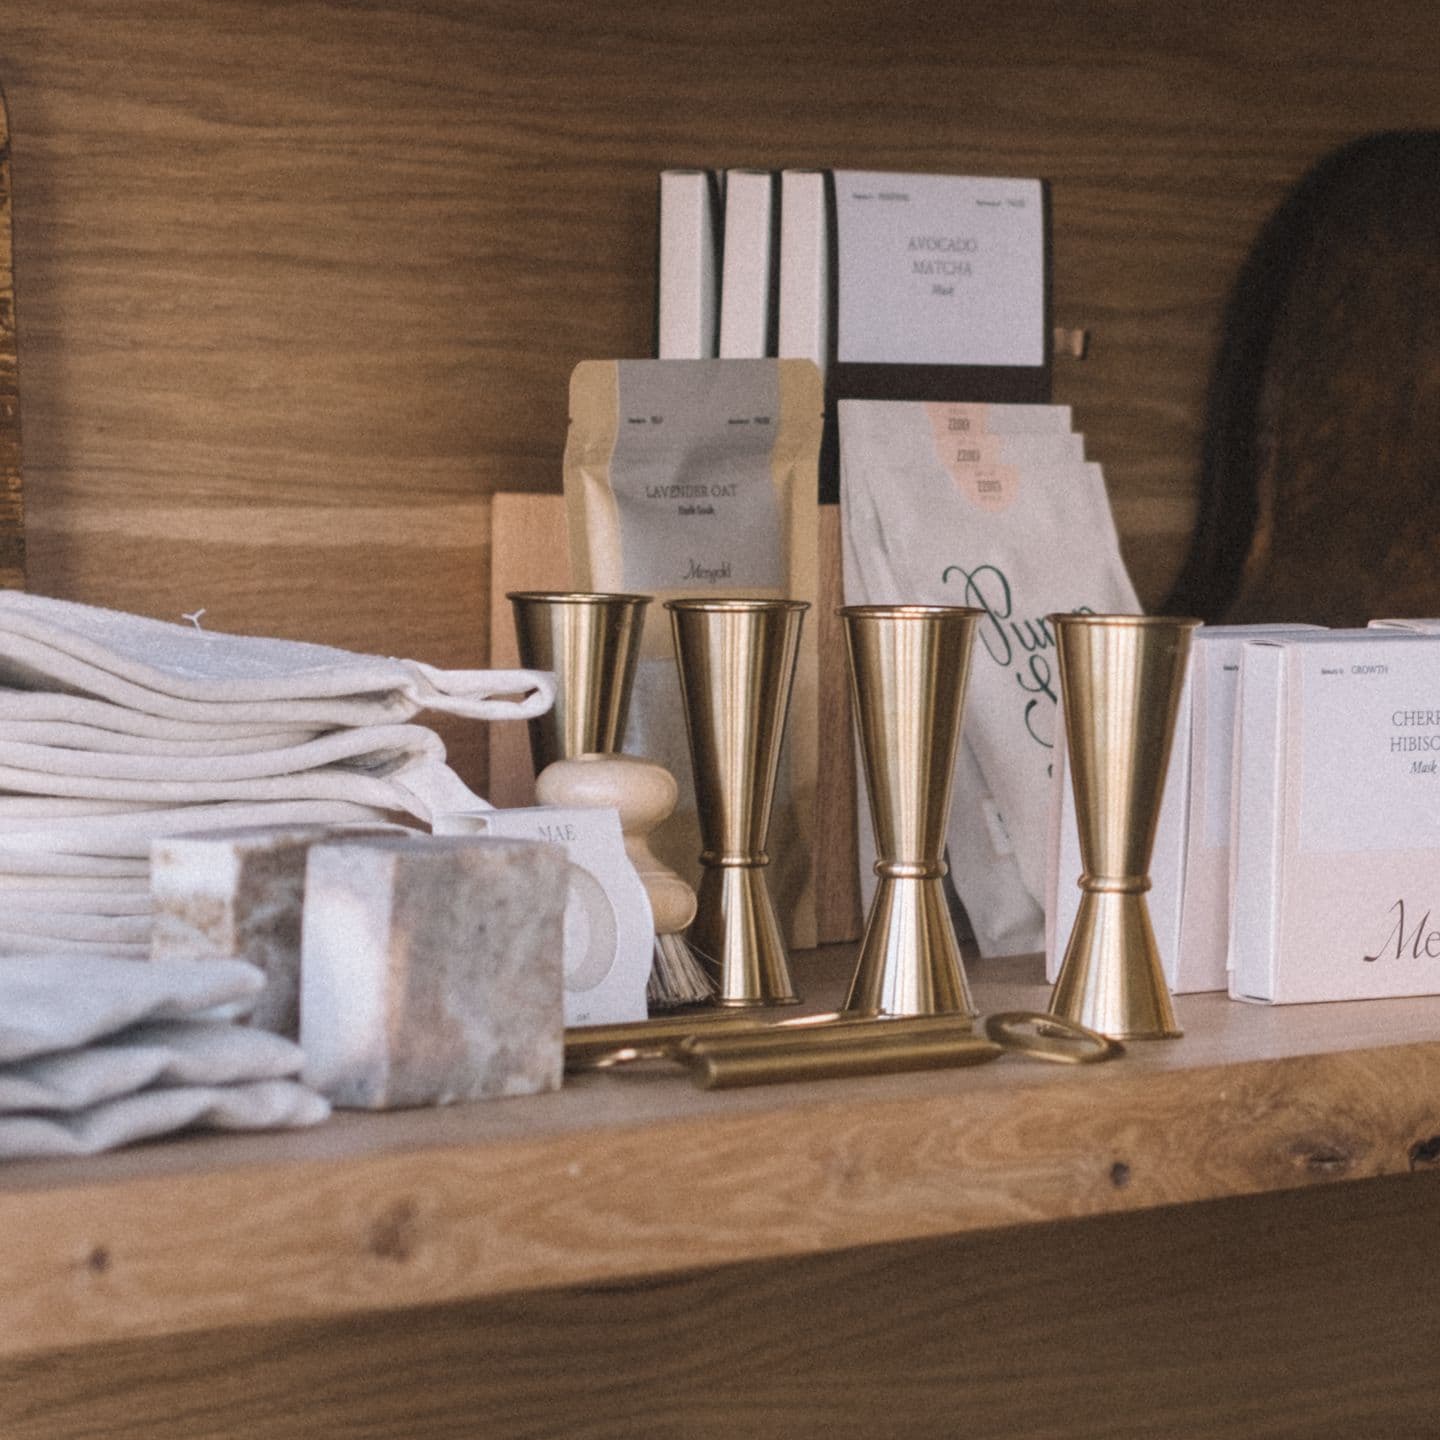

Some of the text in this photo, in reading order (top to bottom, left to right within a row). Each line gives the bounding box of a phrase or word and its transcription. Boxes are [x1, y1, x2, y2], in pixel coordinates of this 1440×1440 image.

[908, 236, 978, 252] AVOCADO
[911, 260, 973, 276] MATCHA
[645, 484, 738, 499] LAVENDER OAT
[1351, 664, 1390, 676] GROWTH
[1409, 760, 1439, 775] Mask
